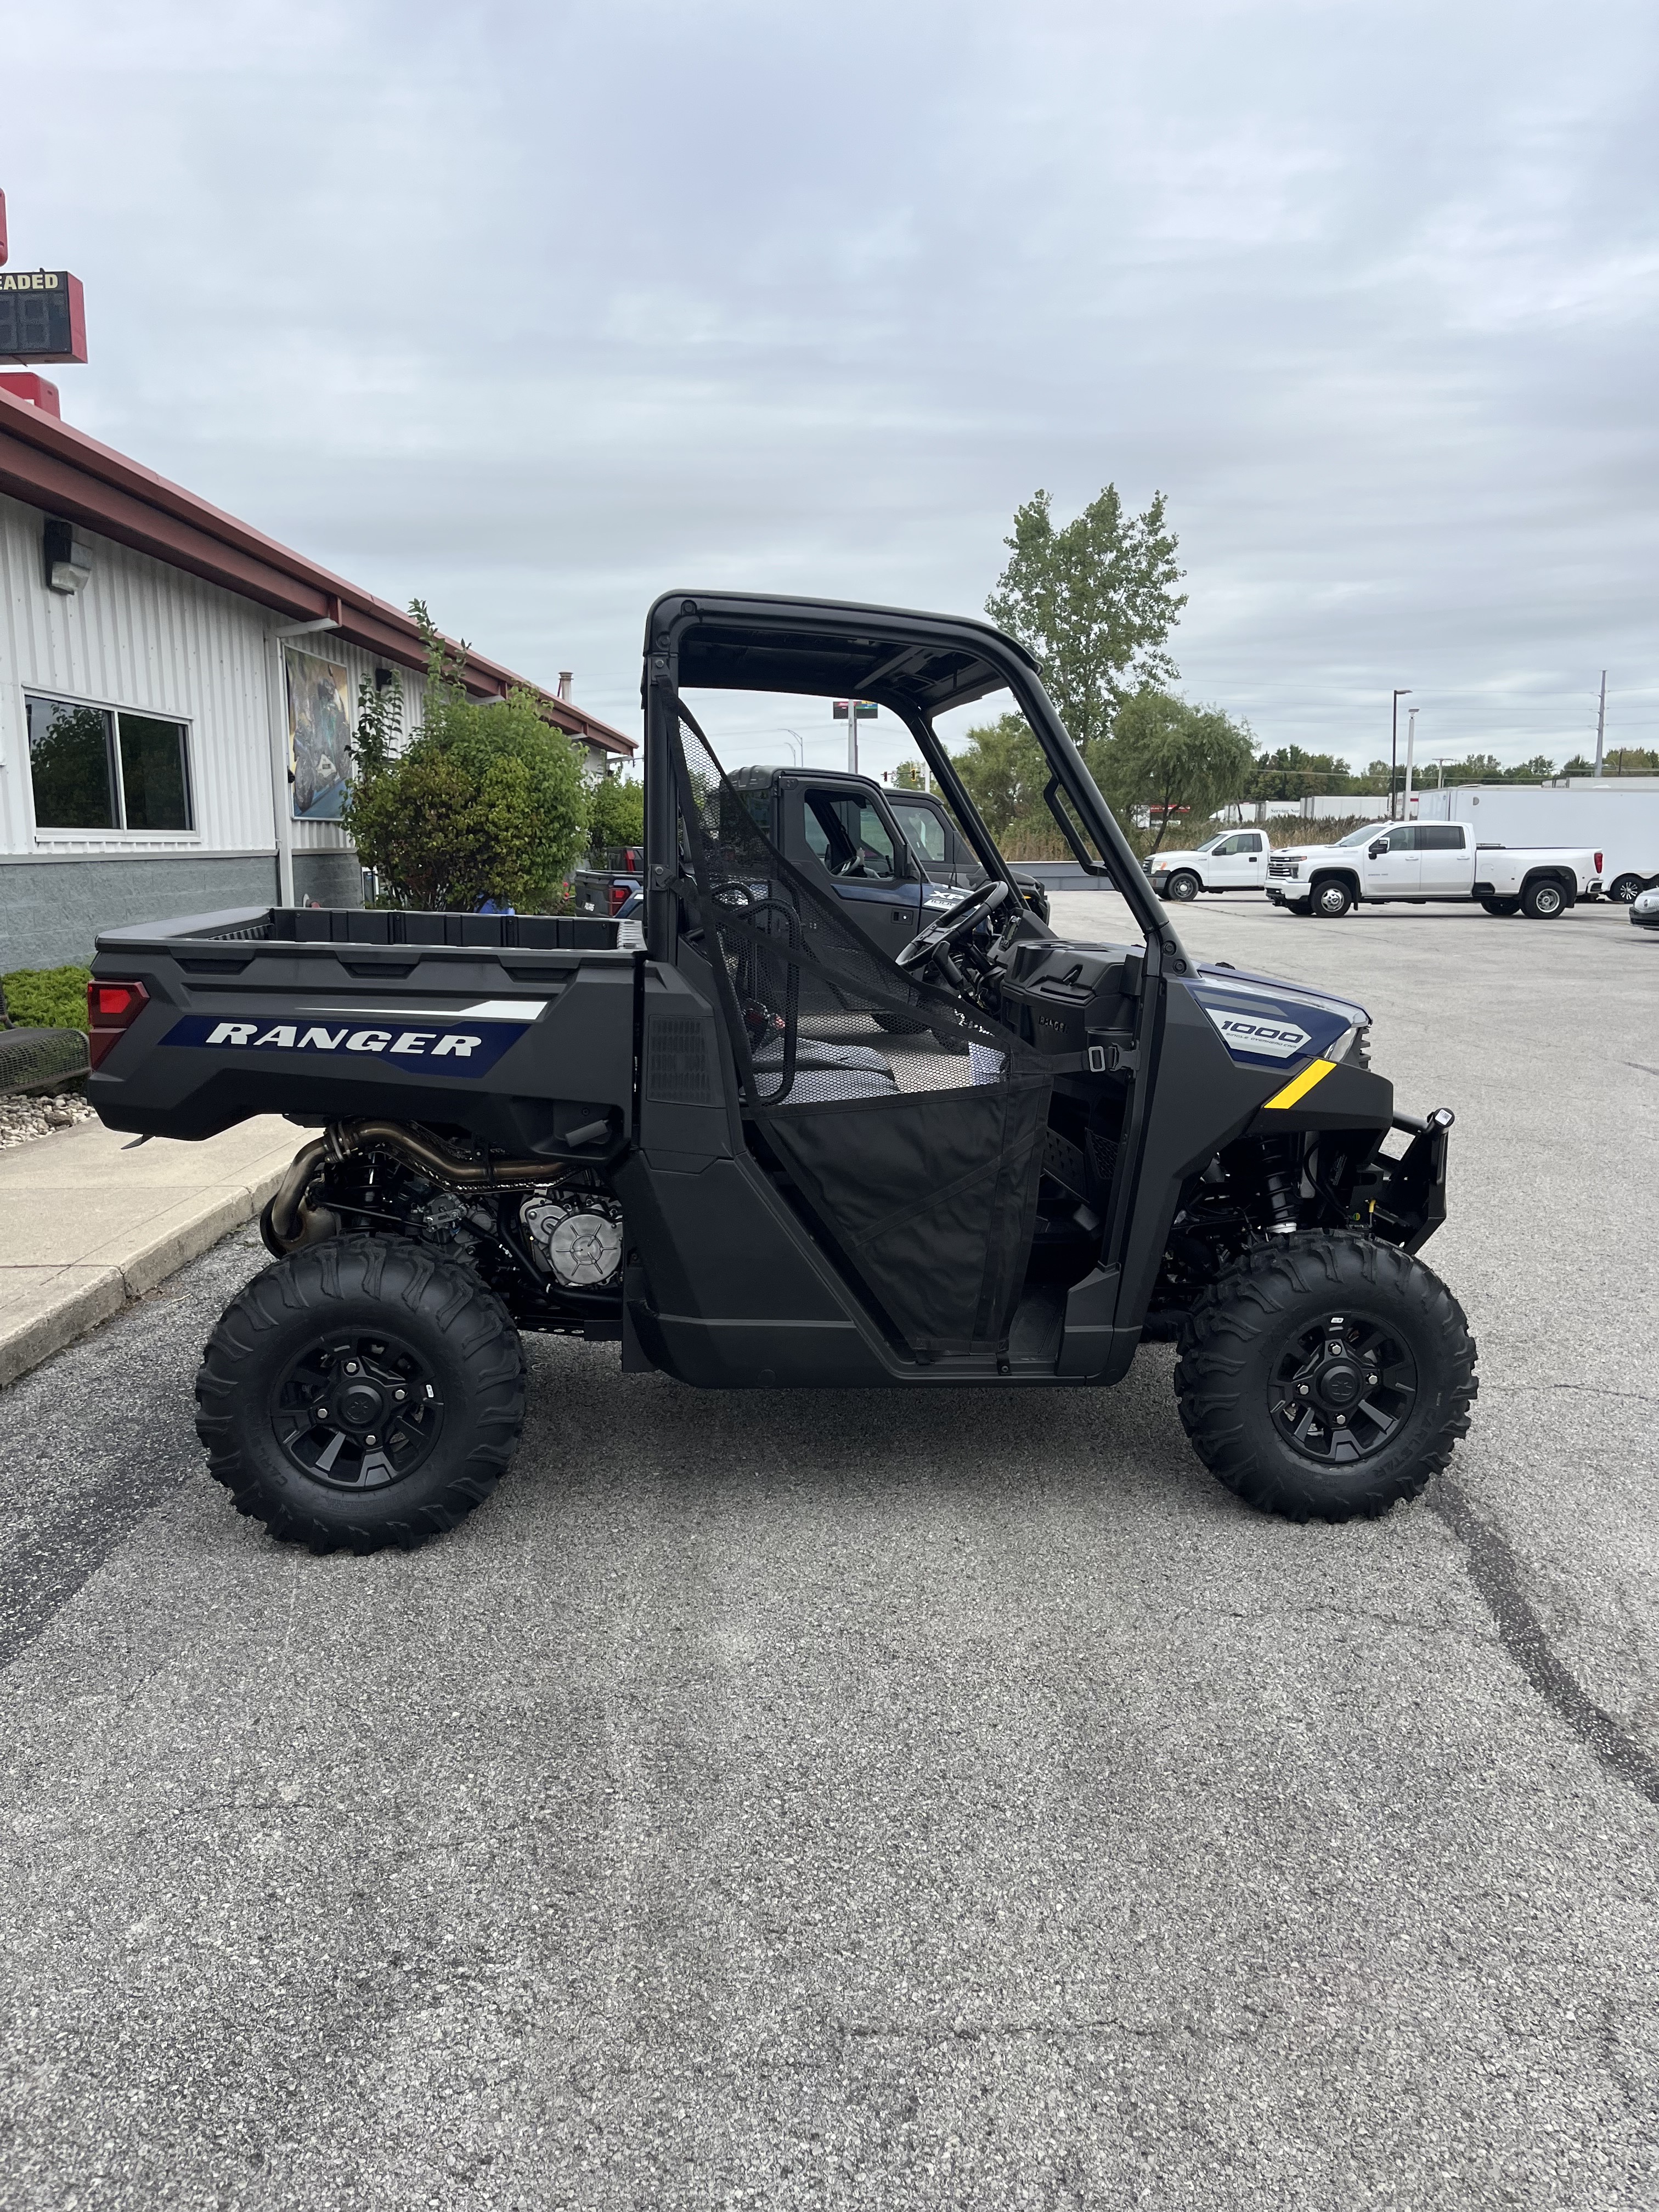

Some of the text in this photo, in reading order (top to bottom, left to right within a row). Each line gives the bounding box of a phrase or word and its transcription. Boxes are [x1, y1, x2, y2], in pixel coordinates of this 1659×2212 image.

[0, 274, 58, 290] ADED
[929, 890, 965, 900] XP
[205, 1022, 482, 1057] RANGER
[1221, 1020, 1304, 1043] 1000
[1250, 1037, 1283, 1046] OVERHEAD
